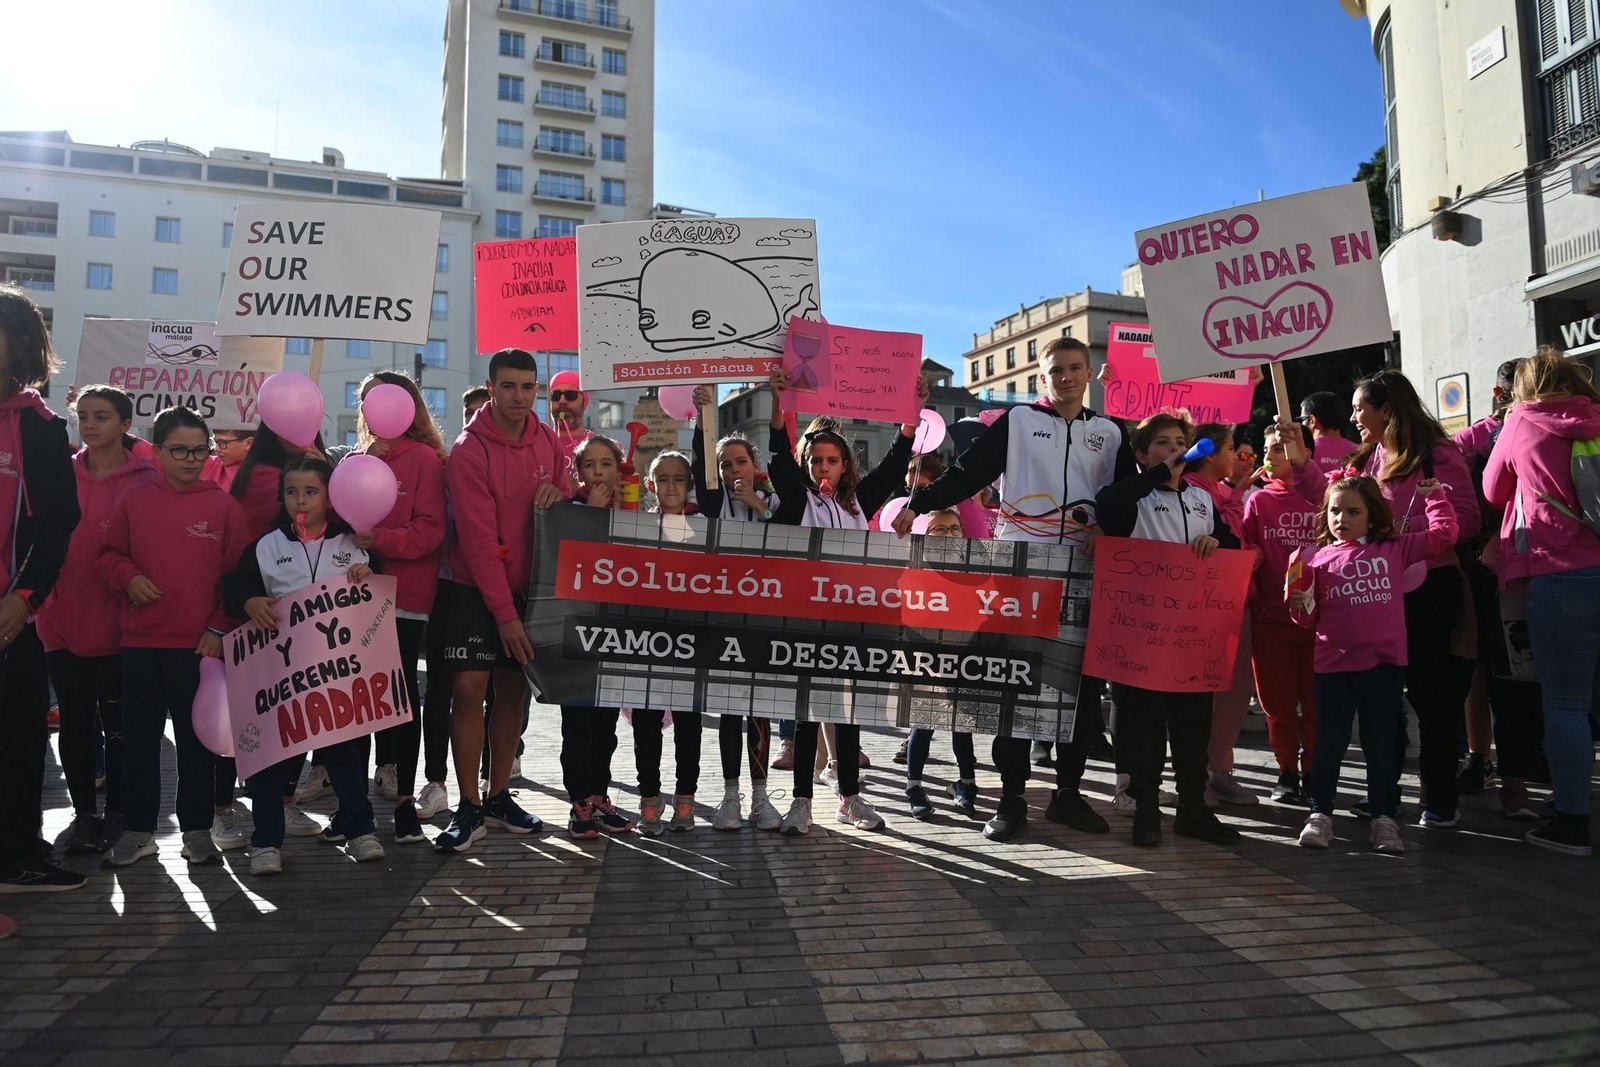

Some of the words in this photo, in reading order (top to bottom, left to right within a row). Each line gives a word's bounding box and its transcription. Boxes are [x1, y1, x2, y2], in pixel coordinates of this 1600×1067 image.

[248, 220, 325, 245] SAVE
[1138, 213, 1259, 267] QUIERO
[238, 257, 308, 281] OUR
[1215, 242, 1316, 290] NADAR
[1330, 231, 1373, 266] EN
[235, 292, 413, 322] SWIMMERS
[151, 322, 193, 335] inacua
[1213, 301, 1324, 348] INACUA
[165, 333, 193, 342] málaga
[109, 362, 266, 396] REPARACIÓN
[613, 363, 692, 381] ¡Solución
[701, 363, 754, 375] Inacua
[1032, 430, 1052, 439] vive
[1264, 525, 1316, 540] inacua
[276, 556, 293, 565] vive
[1339, 557, 1389, 580] CDn
[573, 557, 783, 599] ¡Solución
[810, 575, 950, 613] Inacua
[975, 588, 1042, 620] Ya!
[1326, 576, 1392, 600] inacua
[1350, 591, 1392, 605] málaga
[1163, 596, 1182, 610] DE
[276, 637, 293, 667] Y
[575, 624, 696, 660] VAMOS
[719, 637, 746, 663] A
[769, 639, 1034, 687] DESAPARECER
[255, 654, 362, 715] QUEREMOS
